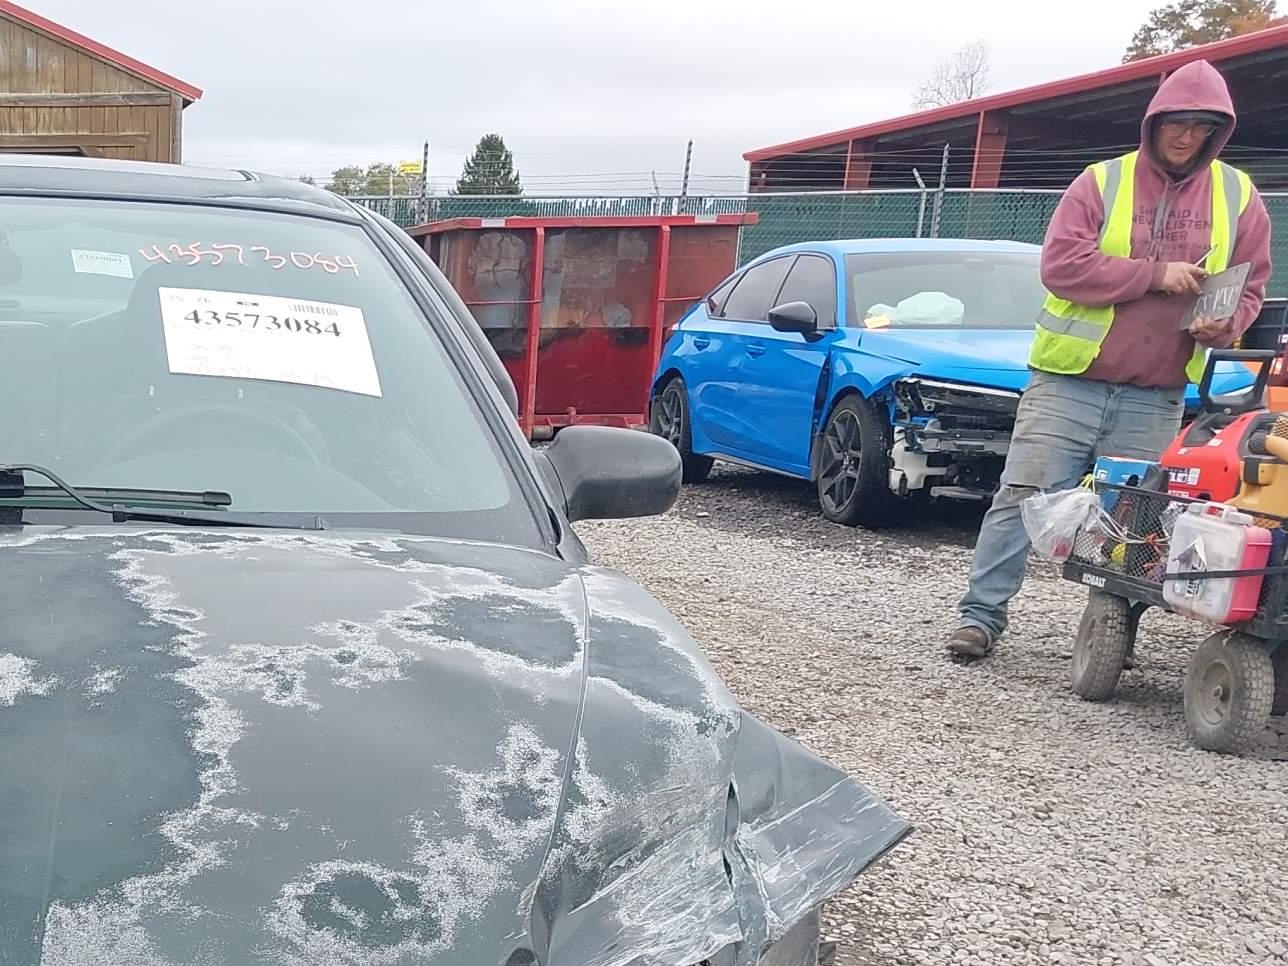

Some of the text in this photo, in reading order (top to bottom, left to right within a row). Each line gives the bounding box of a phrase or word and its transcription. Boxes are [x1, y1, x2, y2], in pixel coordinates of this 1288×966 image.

[1166, 209, 1191, 219] AID
[1166, 220, 1211, 230] LISTEN
[139, 242, 360, 276] 43573084
[183, 309, 342, 337] 43573084
